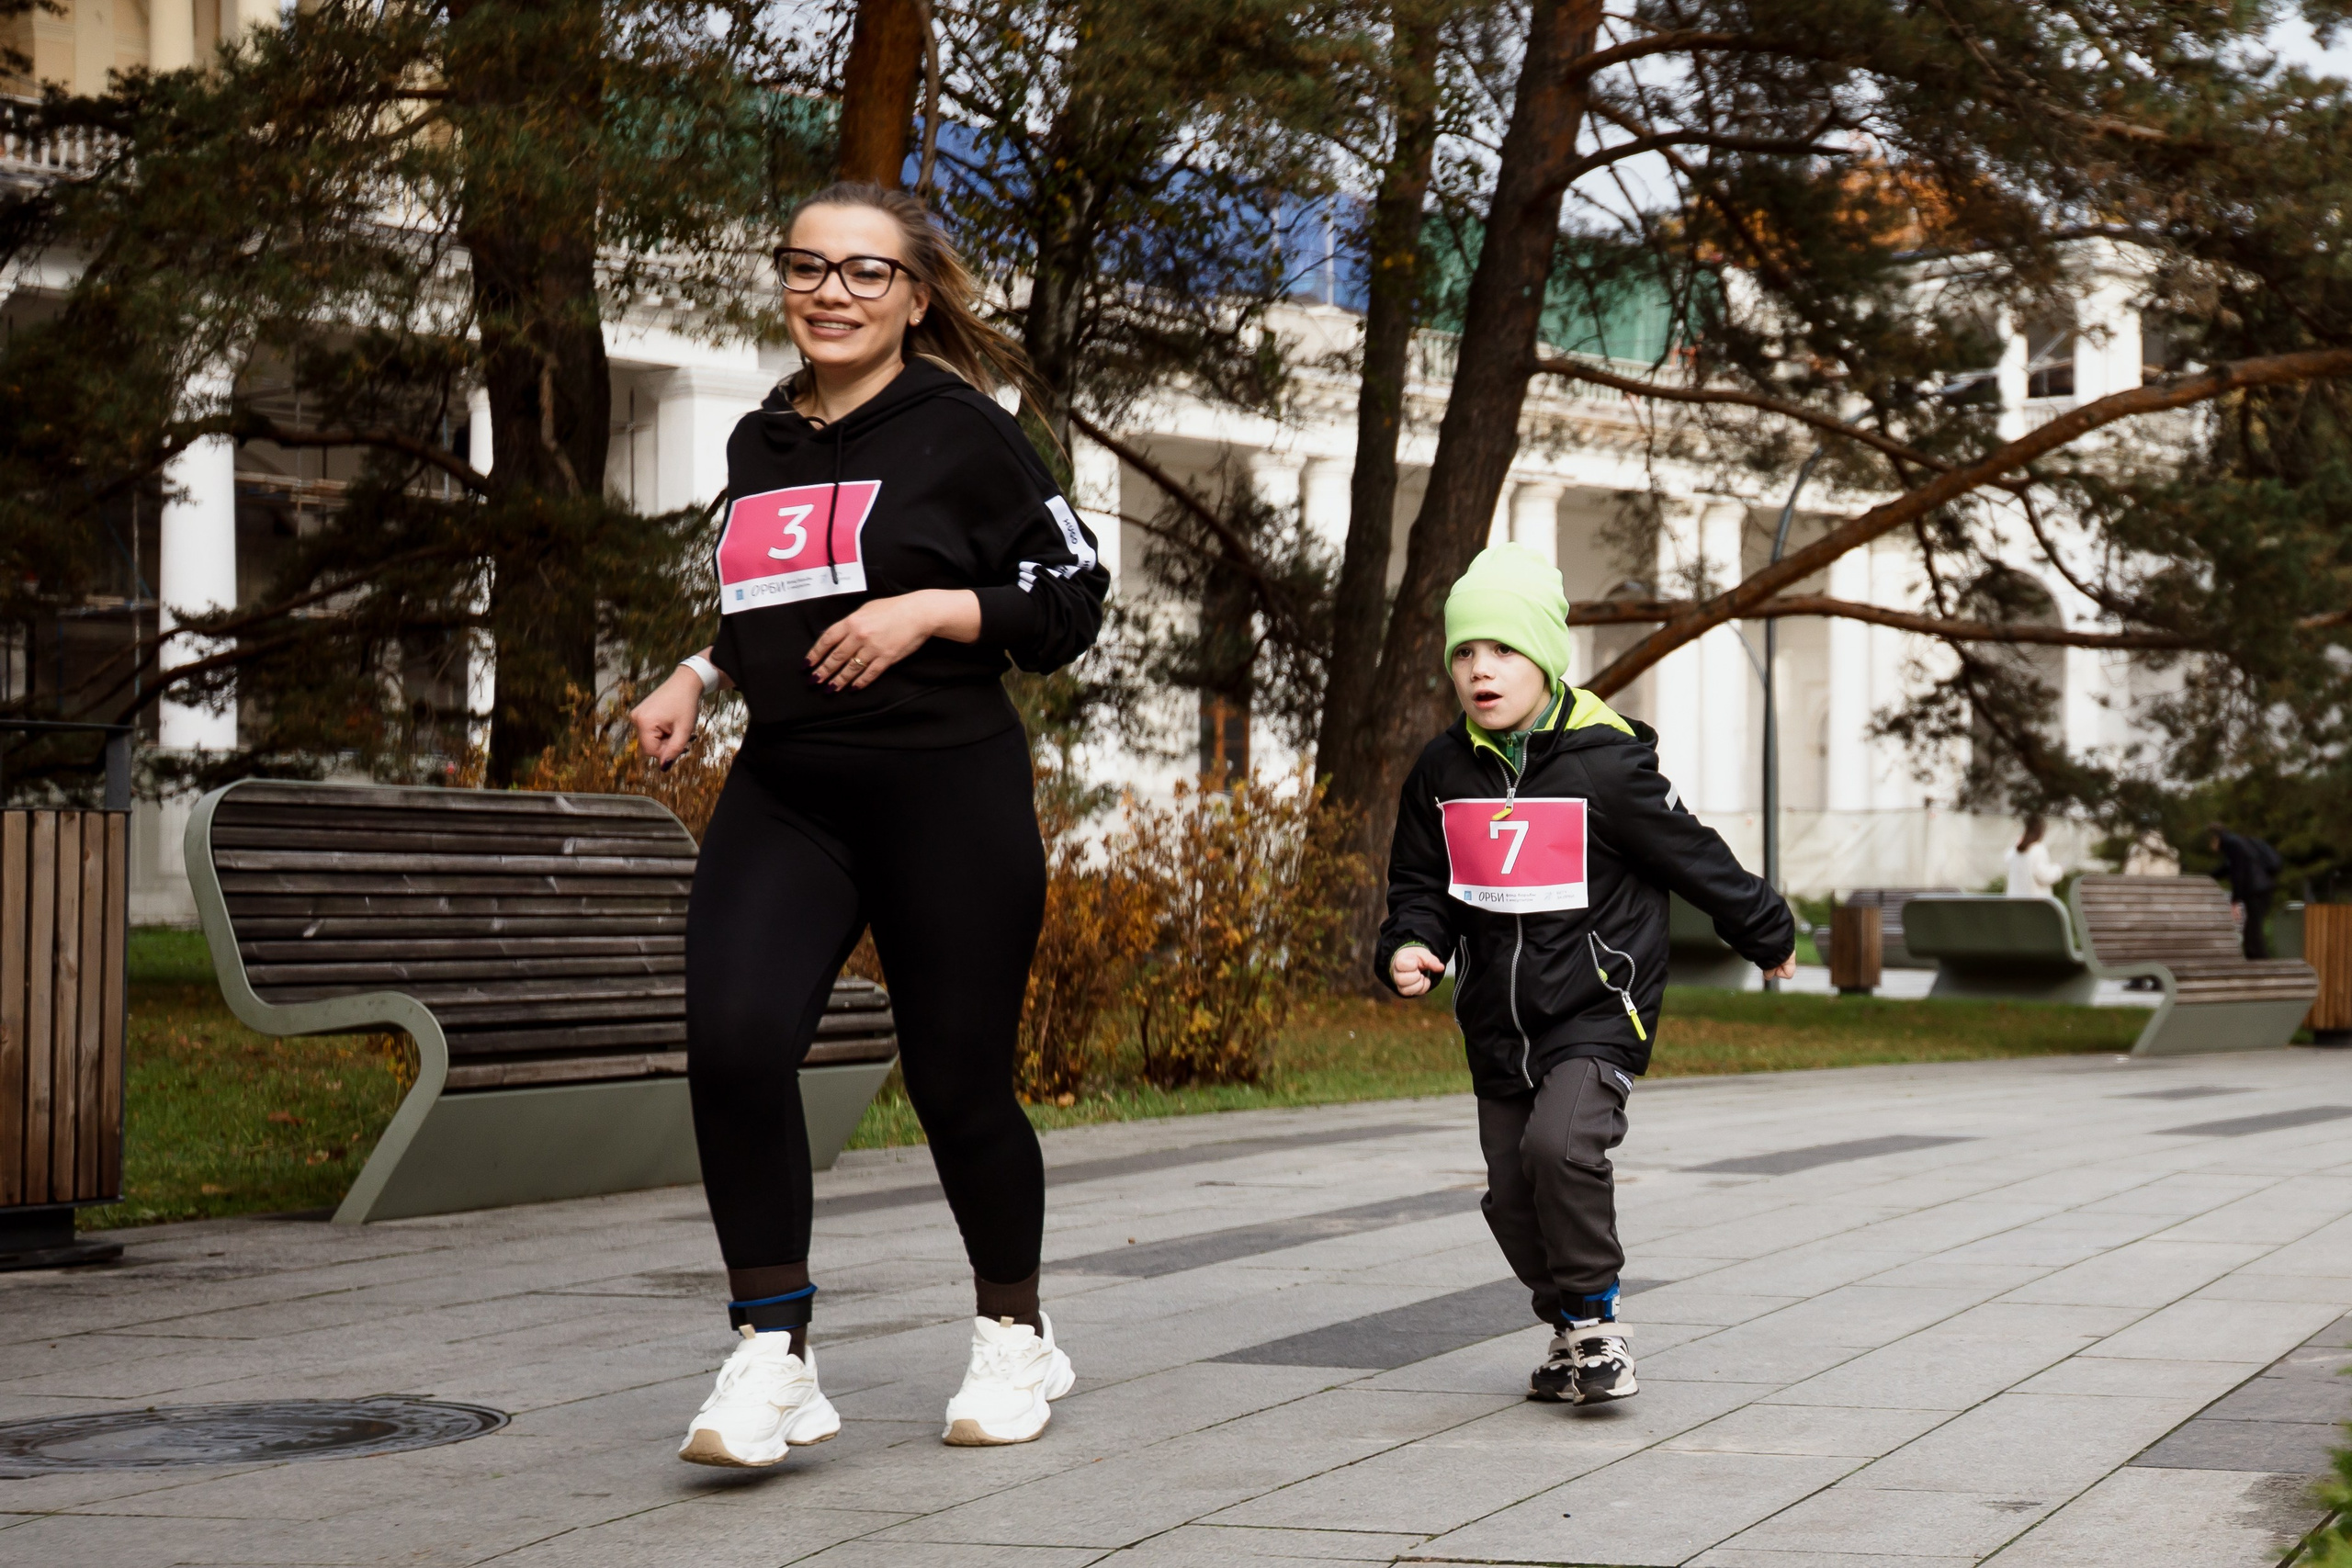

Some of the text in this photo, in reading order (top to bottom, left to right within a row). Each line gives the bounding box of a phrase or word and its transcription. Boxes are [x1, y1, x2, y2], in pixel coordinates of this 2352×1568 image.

[767, 503, 815, 559] 3
[1063, 518, 1079, 545] HUGO
[751, 581, 786, 597] ОРБИ
[1489, 820, 1530, 874] 7
[1478, 891, 1505, 903] ОРБИ
